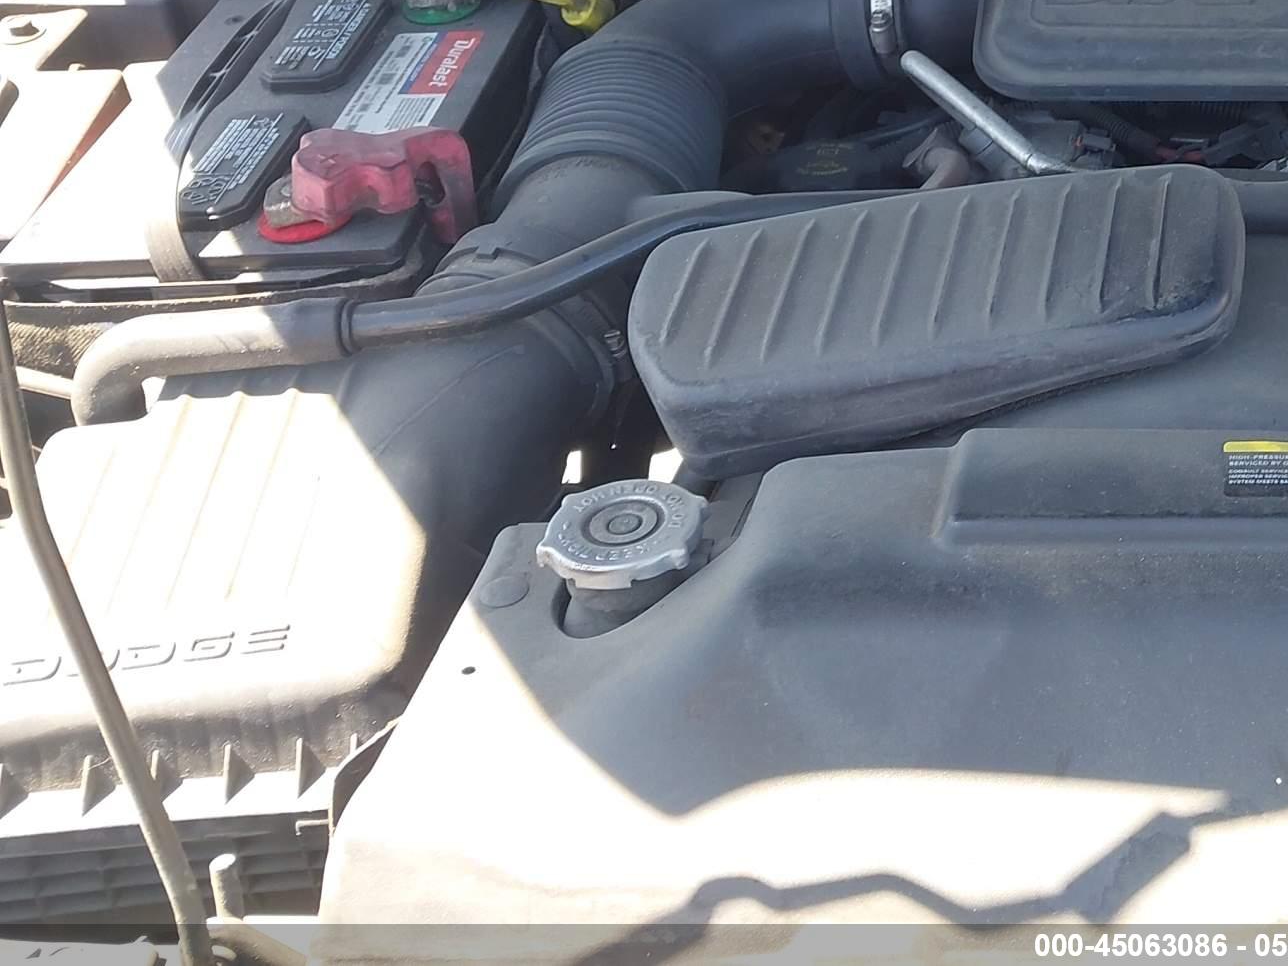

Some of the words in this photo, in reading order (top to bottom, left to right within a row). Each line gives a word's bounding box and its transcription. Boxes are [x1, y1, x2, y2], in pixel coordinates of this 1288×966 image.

[428, 38, 476, 87] Duralast
[609, 484, 659, 495] OPEN
[573, 492, 606, 513] HOT
[662, 493, 686, 511] NOT
[668, 513, 687, 528] DO
